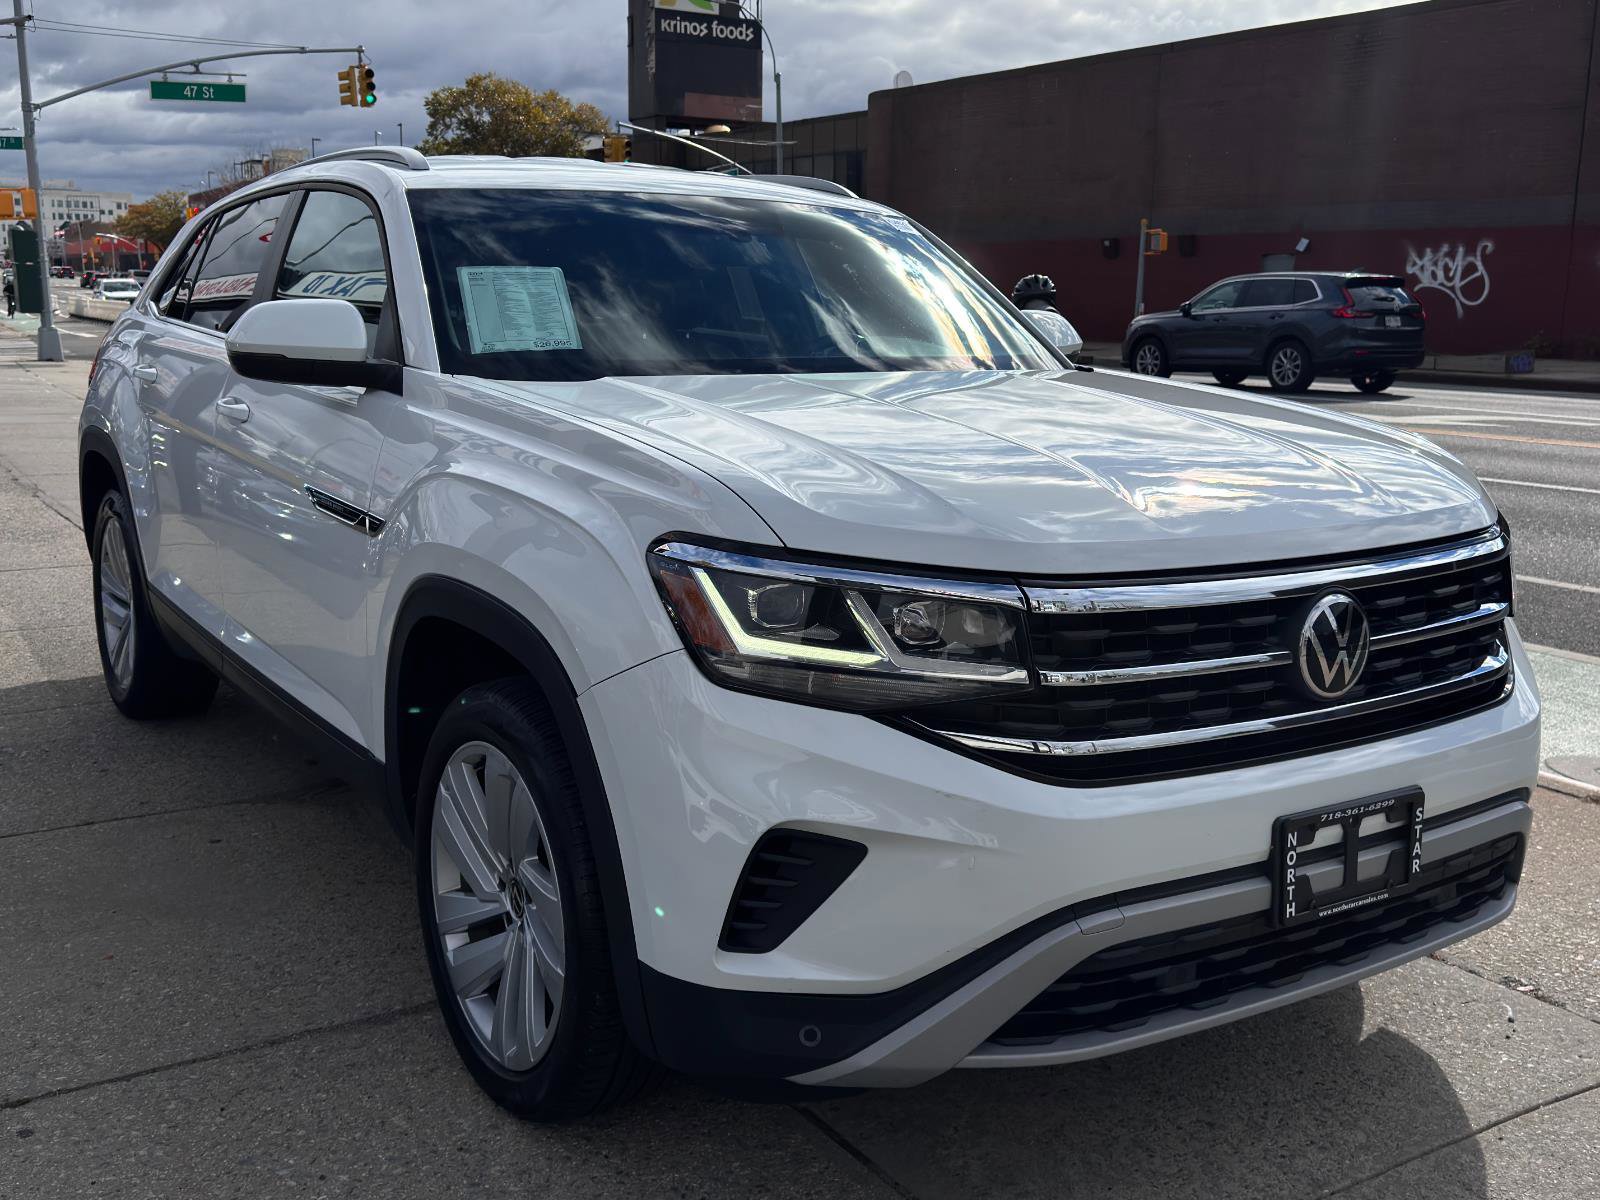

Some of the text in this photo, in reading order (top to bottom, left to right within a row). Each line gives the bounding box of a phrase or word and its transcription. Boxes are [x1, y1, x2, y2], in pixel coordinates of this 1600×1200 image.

[711, 20, 755, 42] foods
[183, 85, 214, 99] 47 St
[1320, 798, 1395, 823] 718-361-6299
[1412, 806, 1424, 874] STAR
[1286, 831, 1298, 919] NORTH
